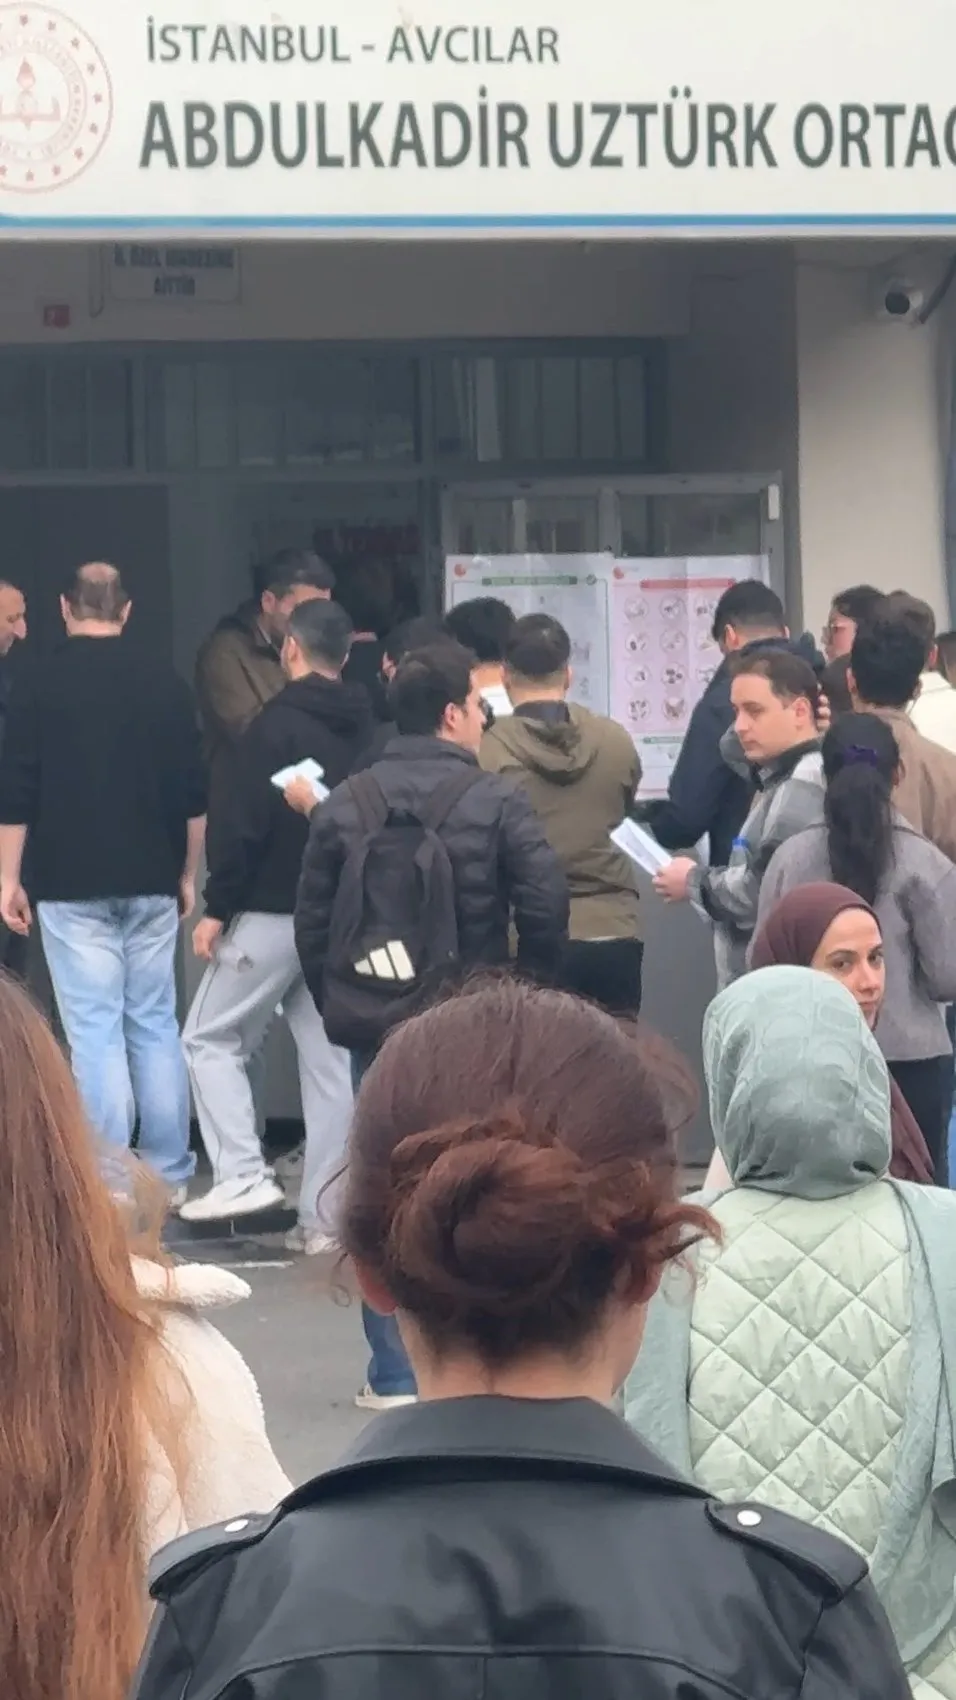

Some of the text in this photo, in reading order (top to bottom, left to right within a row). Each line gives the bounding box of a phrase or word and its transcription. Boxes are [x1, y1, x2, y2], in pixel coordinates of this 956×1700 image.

[147, 17, 350, 62] İSTANBUL
[387, 27, 560, 63] AVCILAR
[139, 86, 531, 169] ABDULKADİR
[548, 86, 778, 169] UZTÜRK
